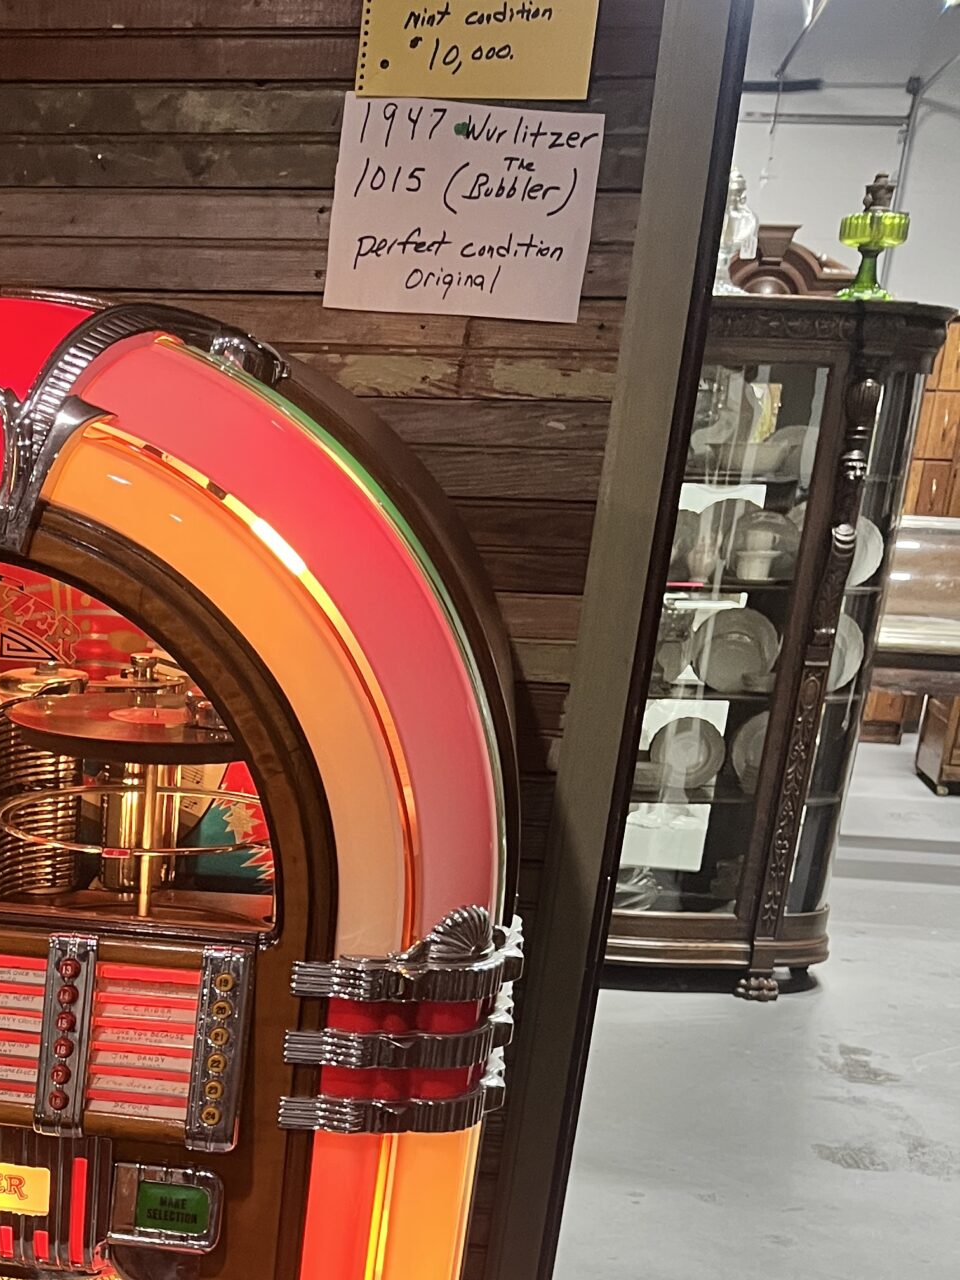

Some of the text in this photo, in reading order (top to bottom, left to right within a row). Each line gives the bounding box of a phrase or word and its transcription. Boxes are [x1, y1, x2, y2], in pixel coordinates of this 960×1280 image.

[464, 1, 553, 26] condition
[360, 101, 599, 149] 1947 Wurlitzer
[503, 156, 536, 173] The
[354, 157, 578, 216] 1015 (Bubbler)
[460, 233, 564, 262] condition
[219, 978, 229, 988] 19
[215, 1005, 227, 1015] 20
[213, 1032, 224, 1042] 21
[210, 1058, 221, 1068] 22
[204, 1111, 216, 1121] 24
[160, 1196, 187, 1210] MAKE
[146, 1208, 198, 1225] SELECTION
